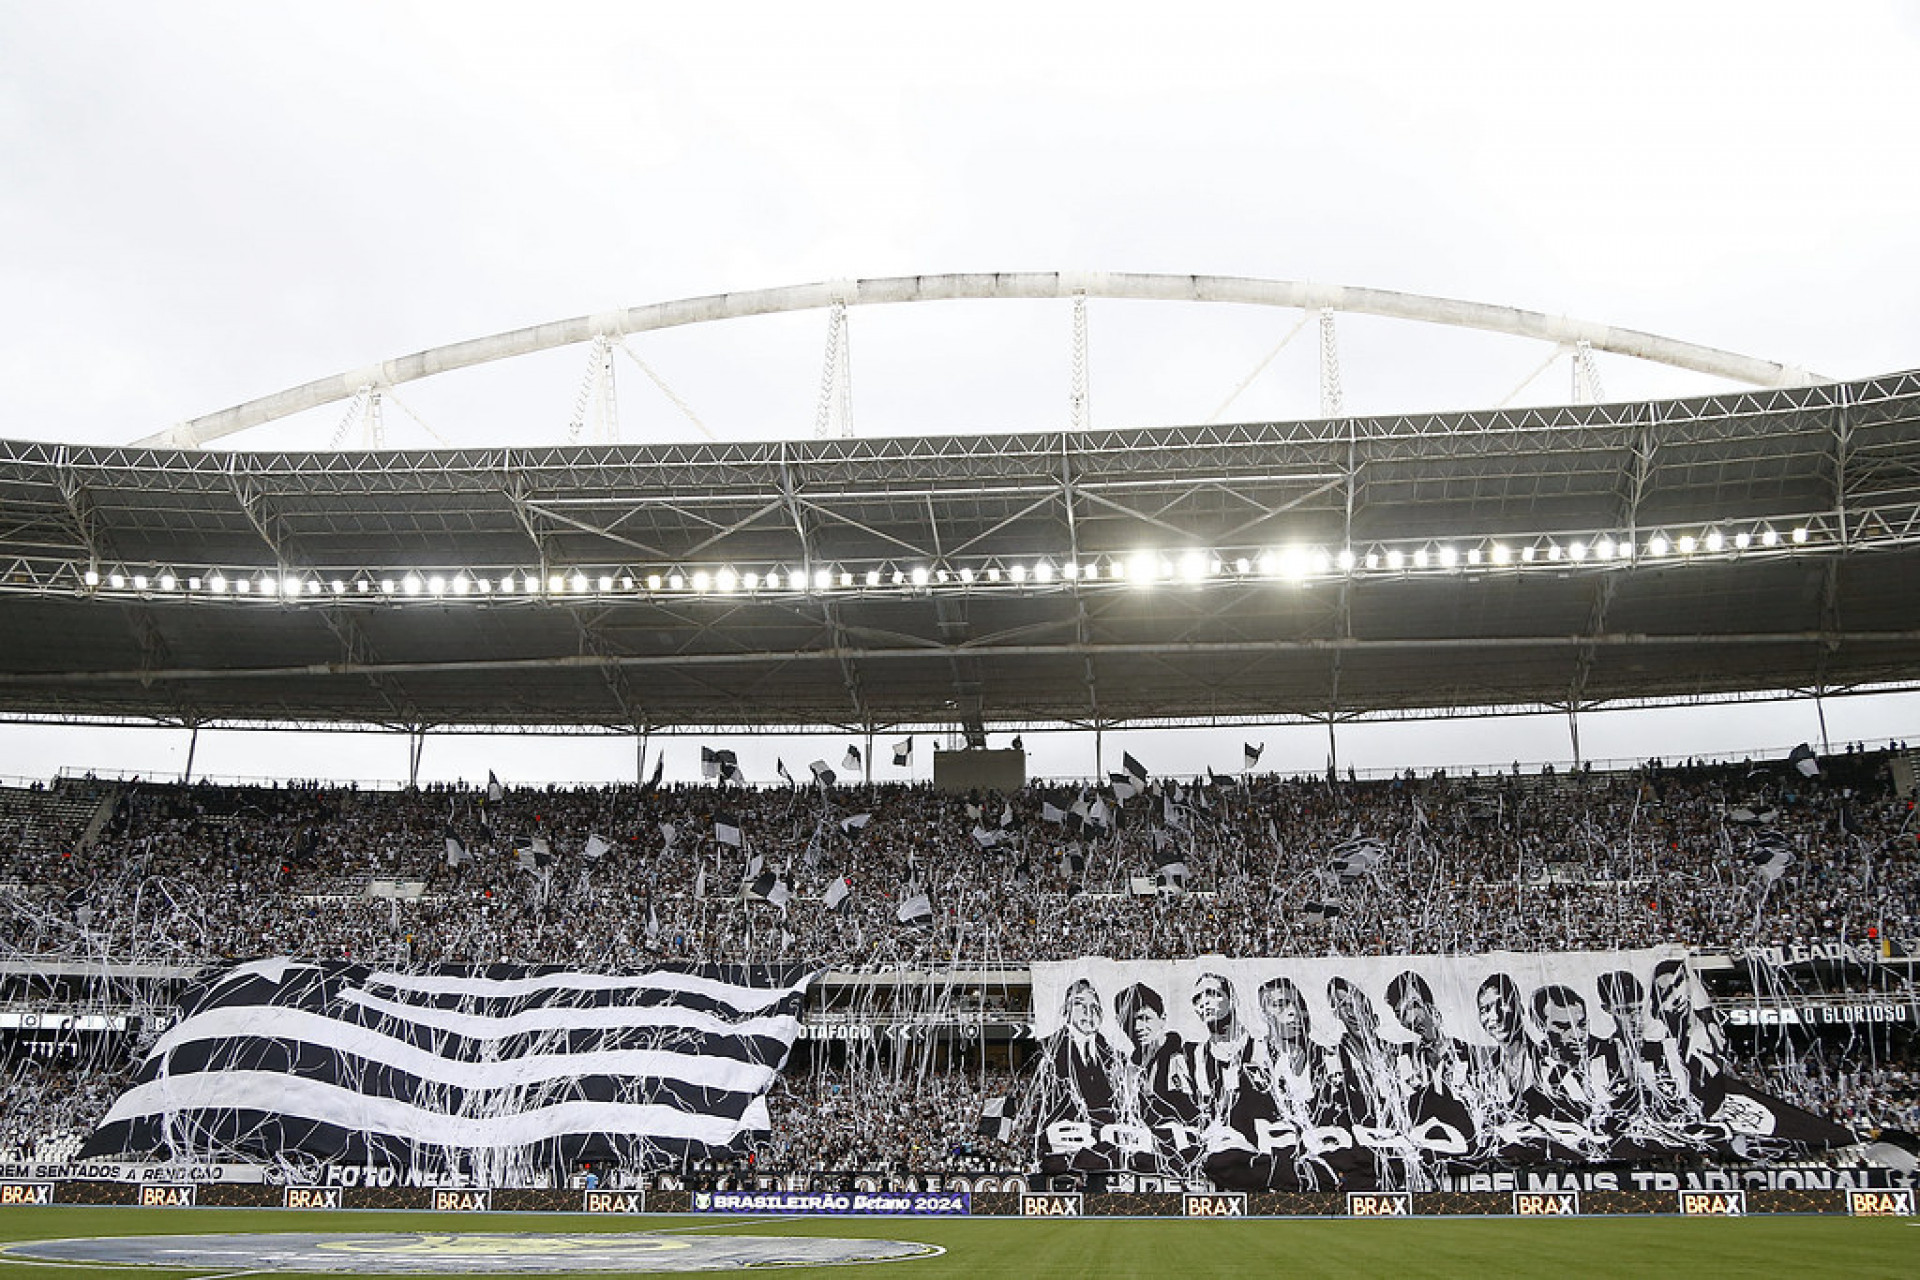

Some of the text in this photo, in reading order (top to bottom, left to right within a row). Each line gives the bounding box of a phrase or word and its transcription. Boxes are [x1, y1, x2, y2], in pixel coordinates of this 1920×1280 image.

[1730, 1005, 1906, 1025] SIGA O GLORIOSO
[798, 1025, 872, 1040] OTAFOGO
[35, 1164, 121, 1178] SENTADOS
[126, 1168, 136, 1180] A
[1527, 1172, 1620, 1192] MAIS
[1630, 1169, 1869, 1191] TRADICIONAL
[2, 1186, 49, 1204] BRAX
[144, 1187, 190, 1206] BRAX
[288, 1190, 338, 1208] BRAX
[437, 1192, 487, 1210] BRAX
[590, 1193, 639, 1212] BRAX
[714, 1194, 963, 1210] BRASILEIRÃO Betano 2024
[1685, 1194, 1741, 1214] BRAX
[1853, 1193, 1909, 1213] BRAX
[1025, 1196, 1078, 1216] BRAX
[1188, 1196, 1242, 1216] BRAX
[1353, 1196, 1407, 1215] BRAX
[1518, 1195, 1574, 1215] BRAX
